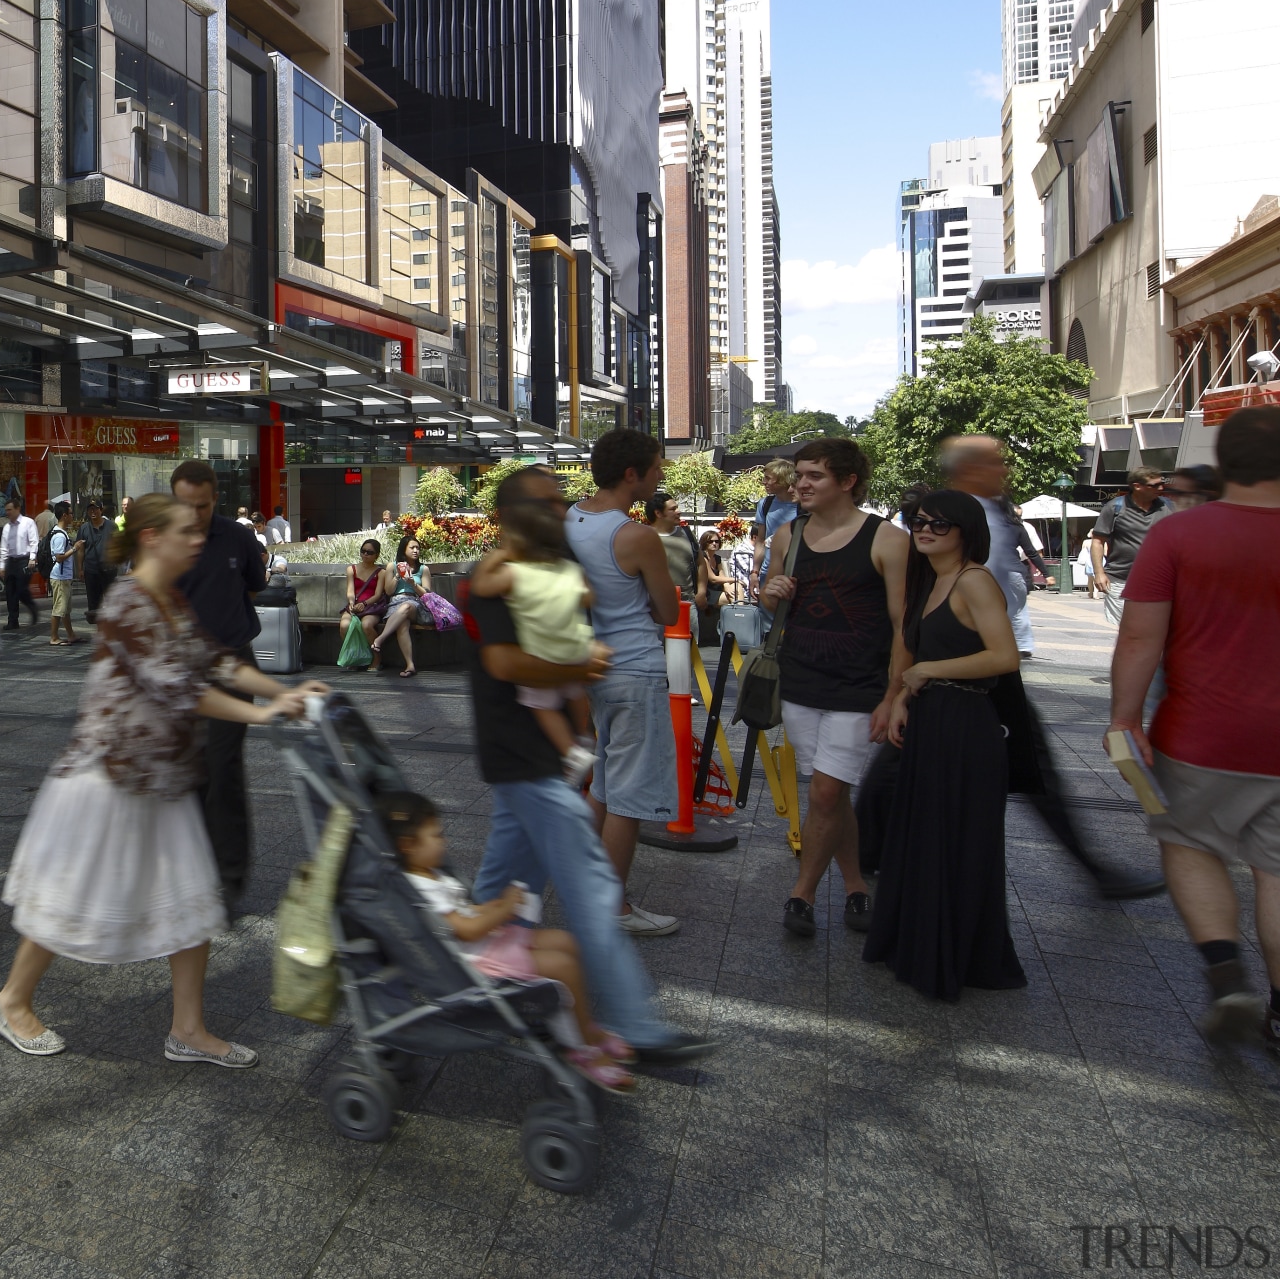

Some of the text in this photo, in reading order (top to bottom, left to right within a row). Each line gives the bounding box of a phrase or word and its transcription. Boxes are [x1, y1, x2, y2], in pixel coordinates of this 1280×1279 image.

[995, 308, 1041, 322] BORD
[177, 371, 241, 388] GUESS
[96, 425, 137, 446] GUESS
[425, 426, 445, 437] nab
